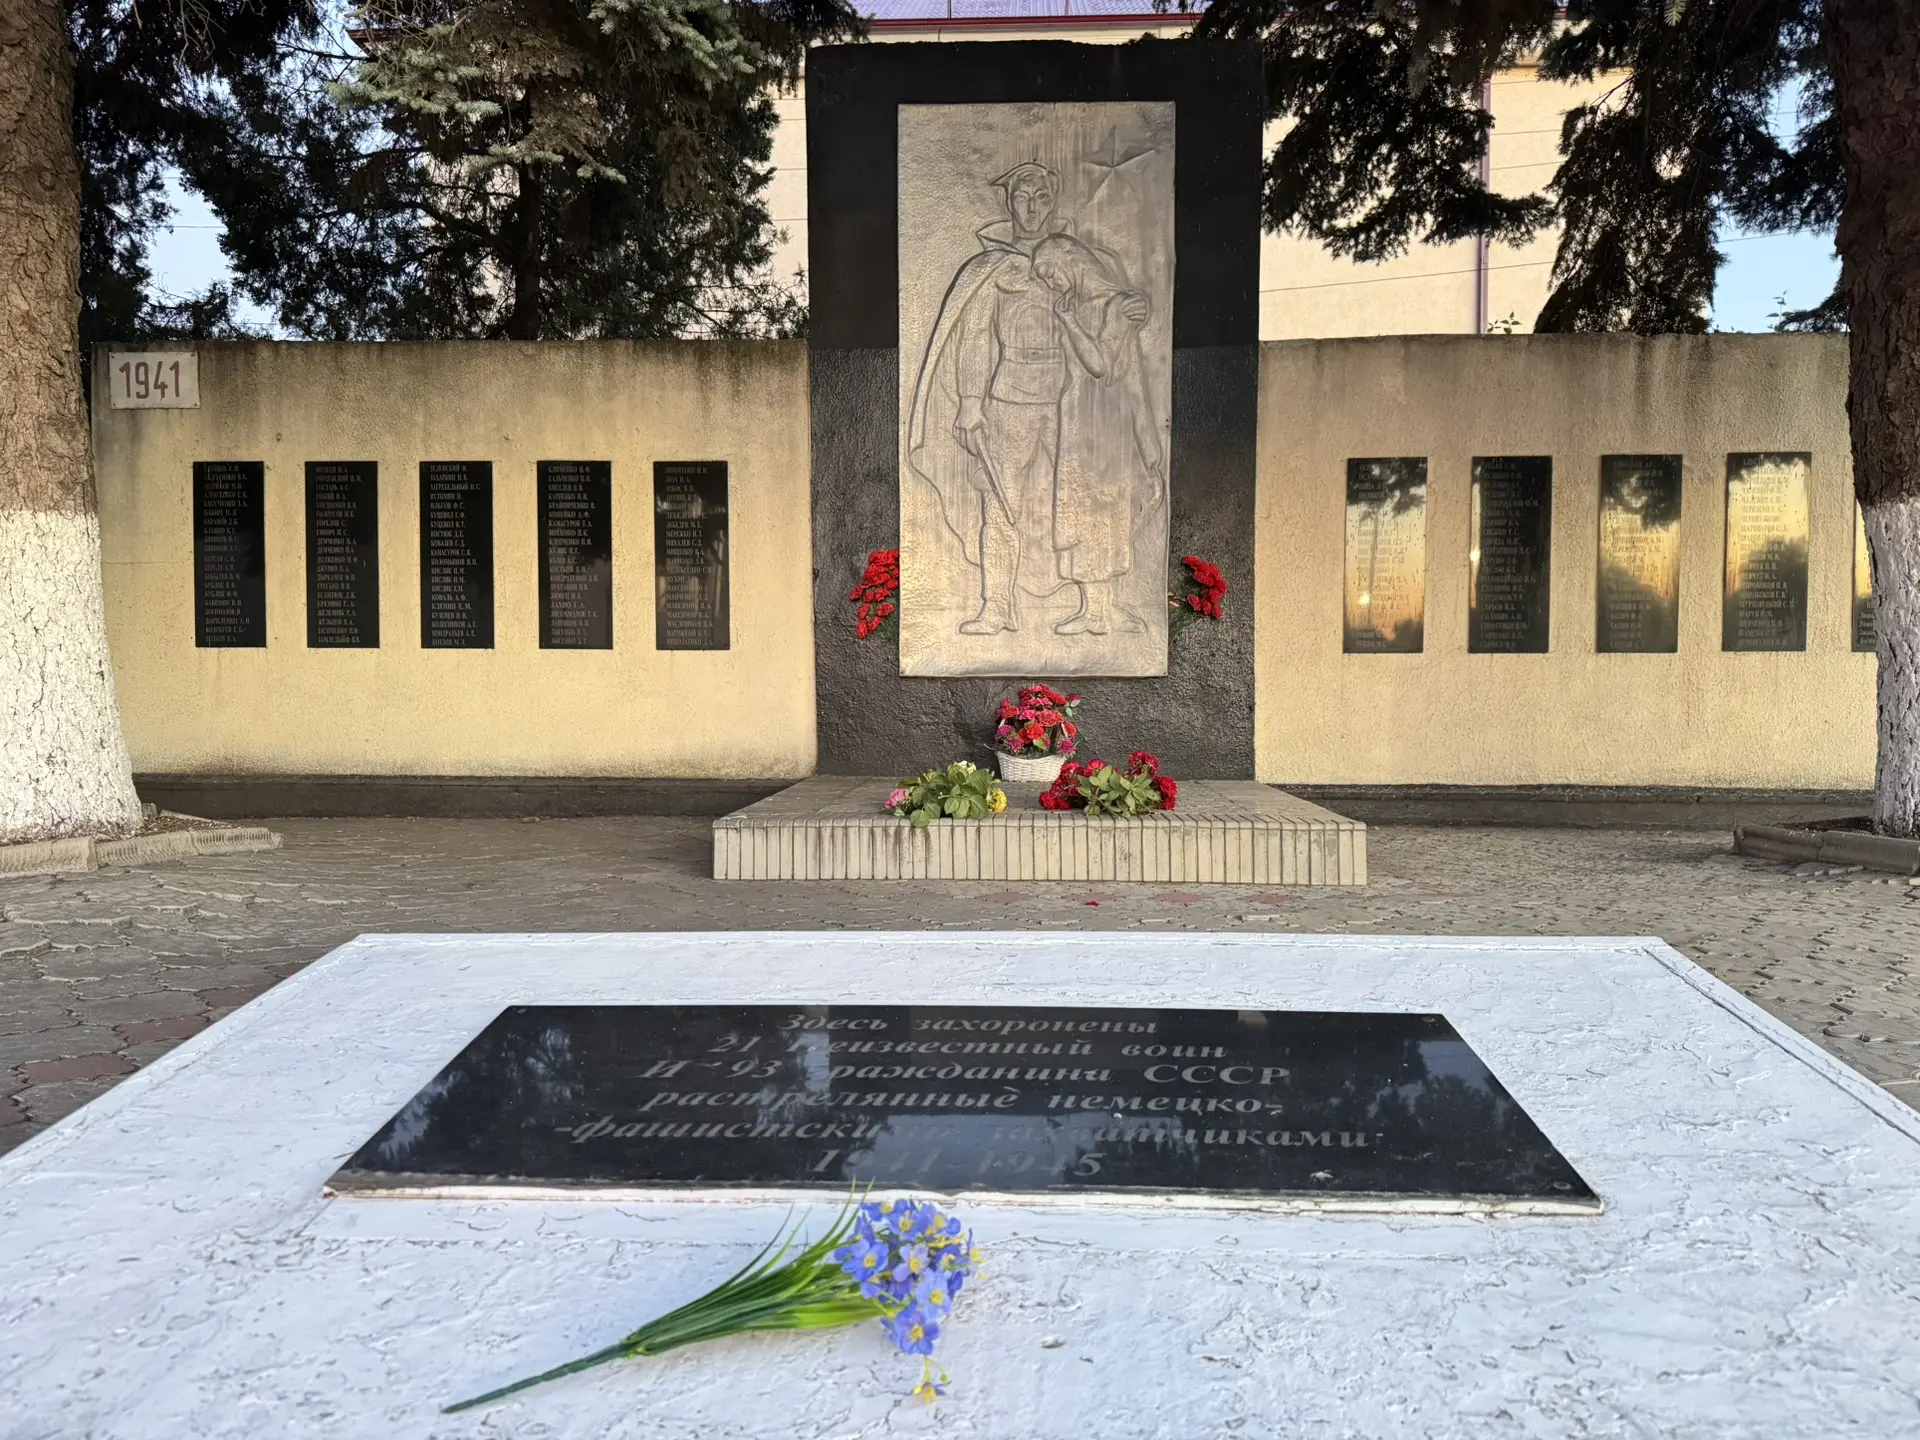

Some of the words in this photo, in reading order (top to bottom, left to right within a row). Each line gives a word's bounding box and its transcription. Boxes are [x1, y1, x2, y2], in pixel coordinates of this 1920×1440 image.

[118, 360, 181, 400] 1941
[914, 1018, 1158, 1035] захоронены
[708, 1036, 761, 1053] 21
[1121, 1044, 1229, 1059] воин
[726, 1060, 784, 1079] 93
[1143, 1064, 1290, 1085] СССР
[554, 1114, 957, 1143] -фашистски
